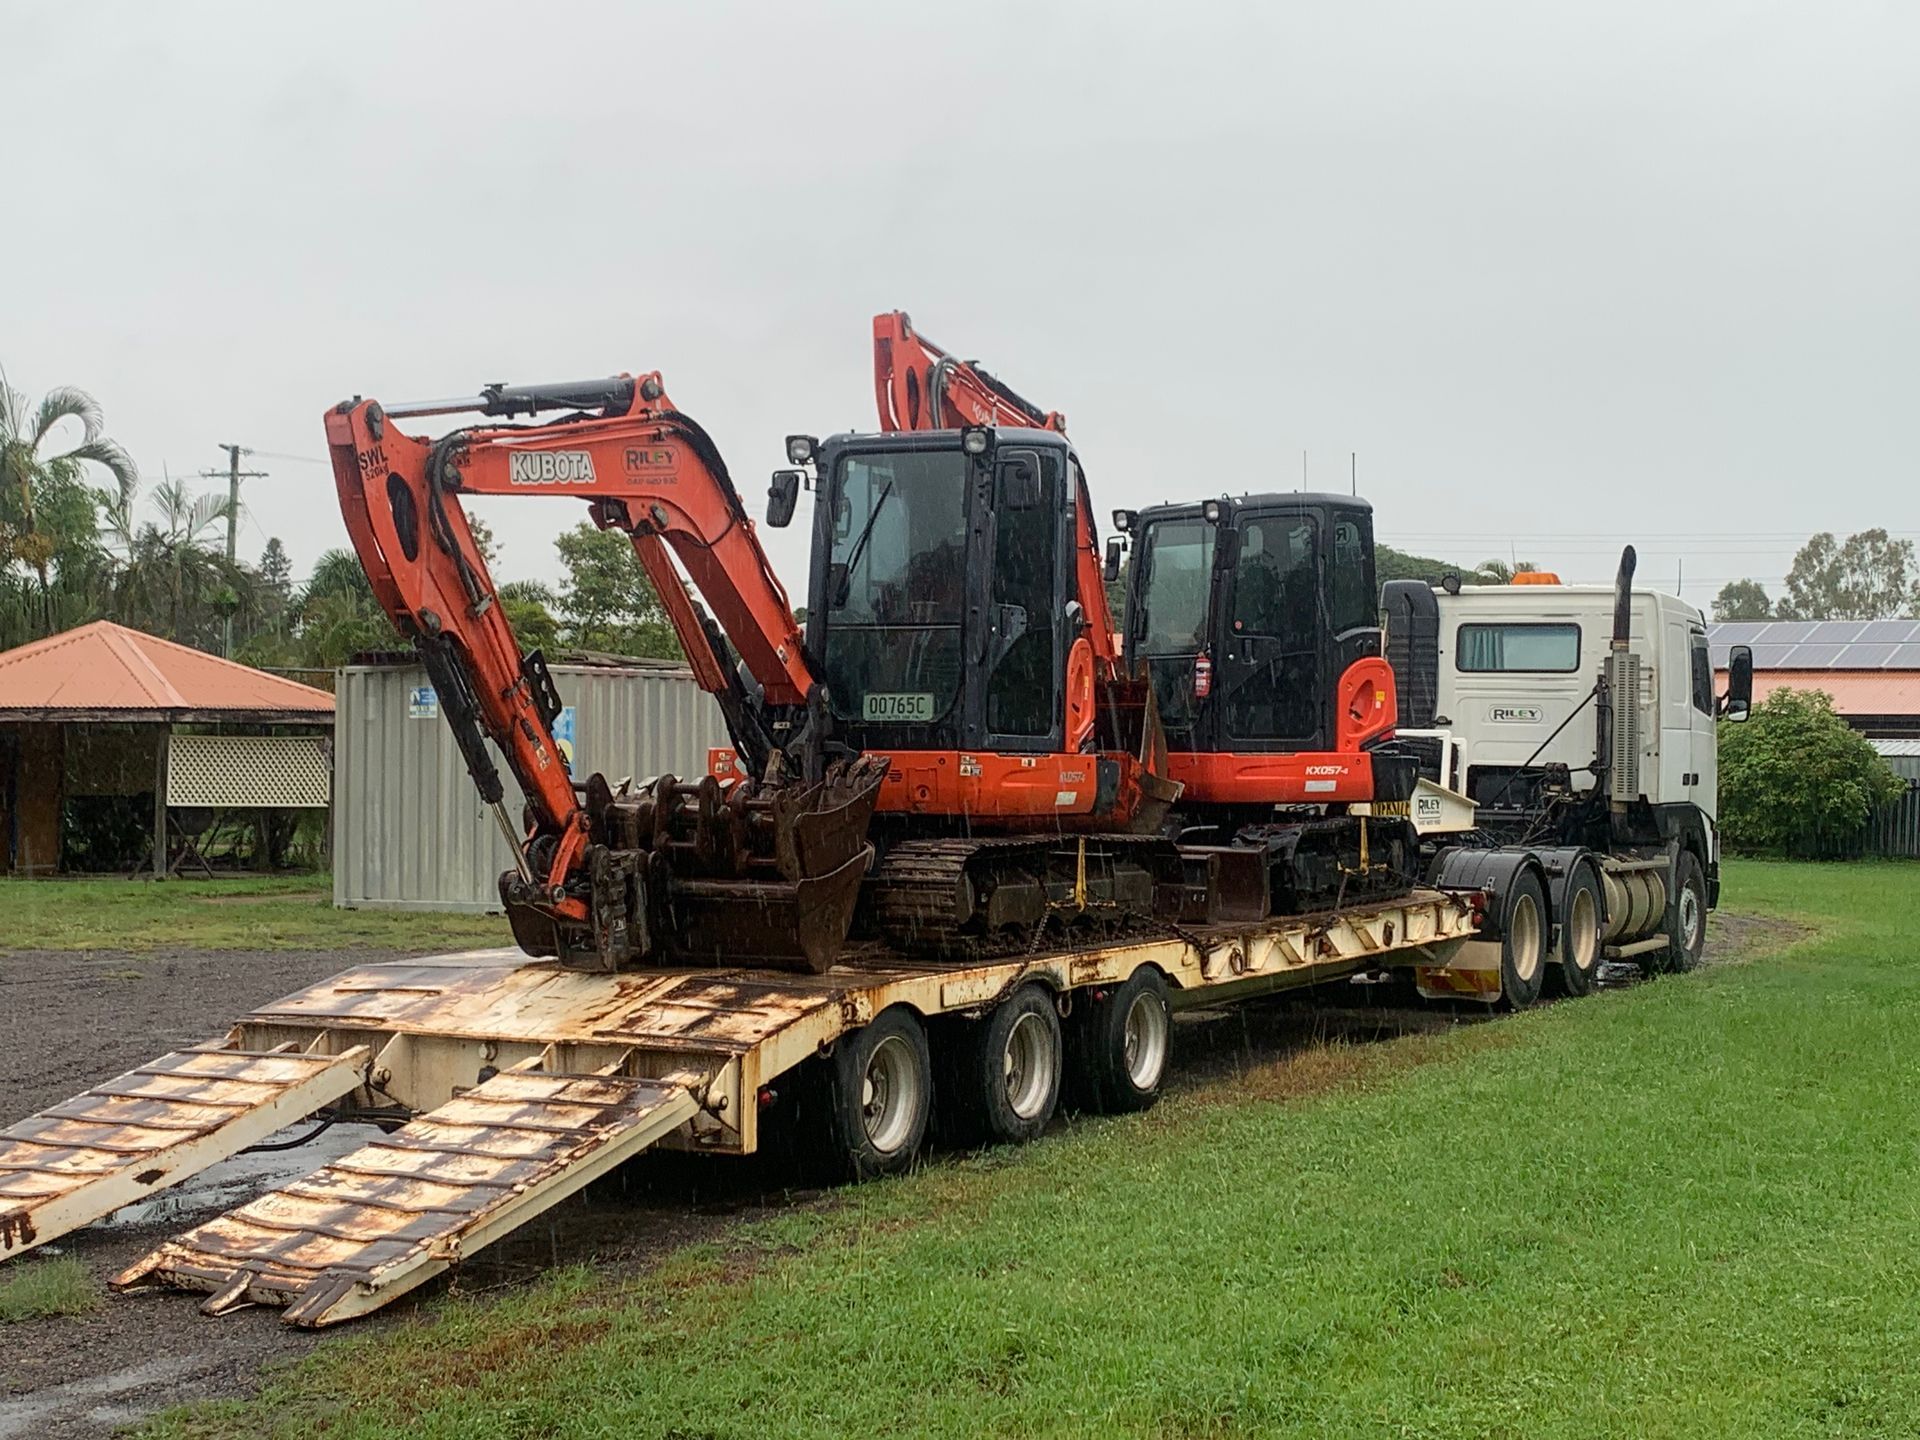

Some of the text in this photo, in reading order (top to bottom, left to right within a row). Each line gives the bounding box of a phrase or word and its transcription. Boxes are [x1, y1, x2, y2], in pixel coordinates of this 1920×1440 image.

[360, 445, 388, 470] SWL
[626, 450, 674, 470] RILEY
[509, 452, 596, 483] KUBOTA
[869, 697, 926, 714] 00765C
[1493, 709, 1538, 720] RILEY
[1305, 765, 1349, 775] KX057-4
[1418, 799, 1441, 815] RILEY
